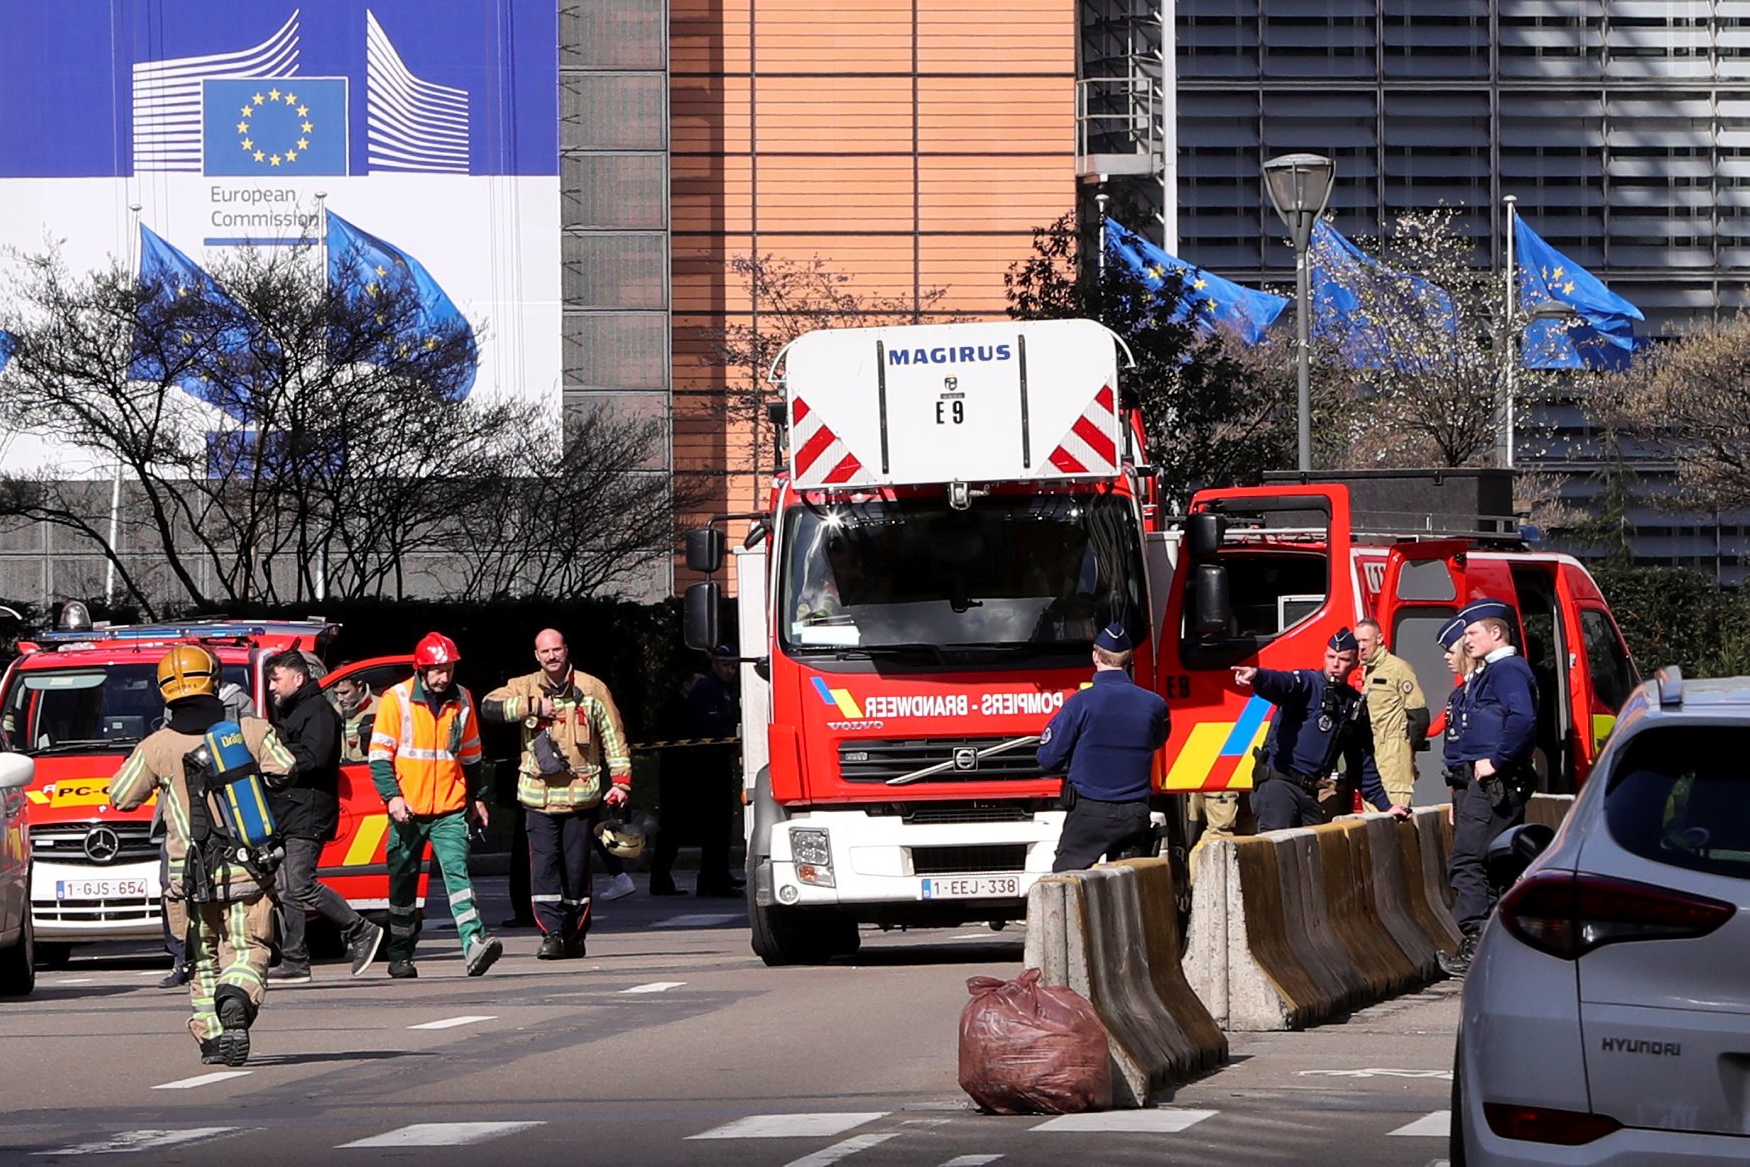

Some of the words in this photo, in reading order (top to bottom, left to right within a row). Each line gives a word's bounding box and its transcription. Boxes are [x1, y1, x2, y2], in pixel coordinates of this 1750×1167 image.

[210, 185, 297, 206] European
[210, 209, 319, 227] Commission
[888, 344, 1012, 366] MAGIRUS
[826, 720, 884, 731] VOLVO
[67, 881, 145, 897] 1-GJS-654
[933, 879, 1017, 896] 1-EEJ-338
[1601, 1037, 1682, 1057] HYUNDAI
